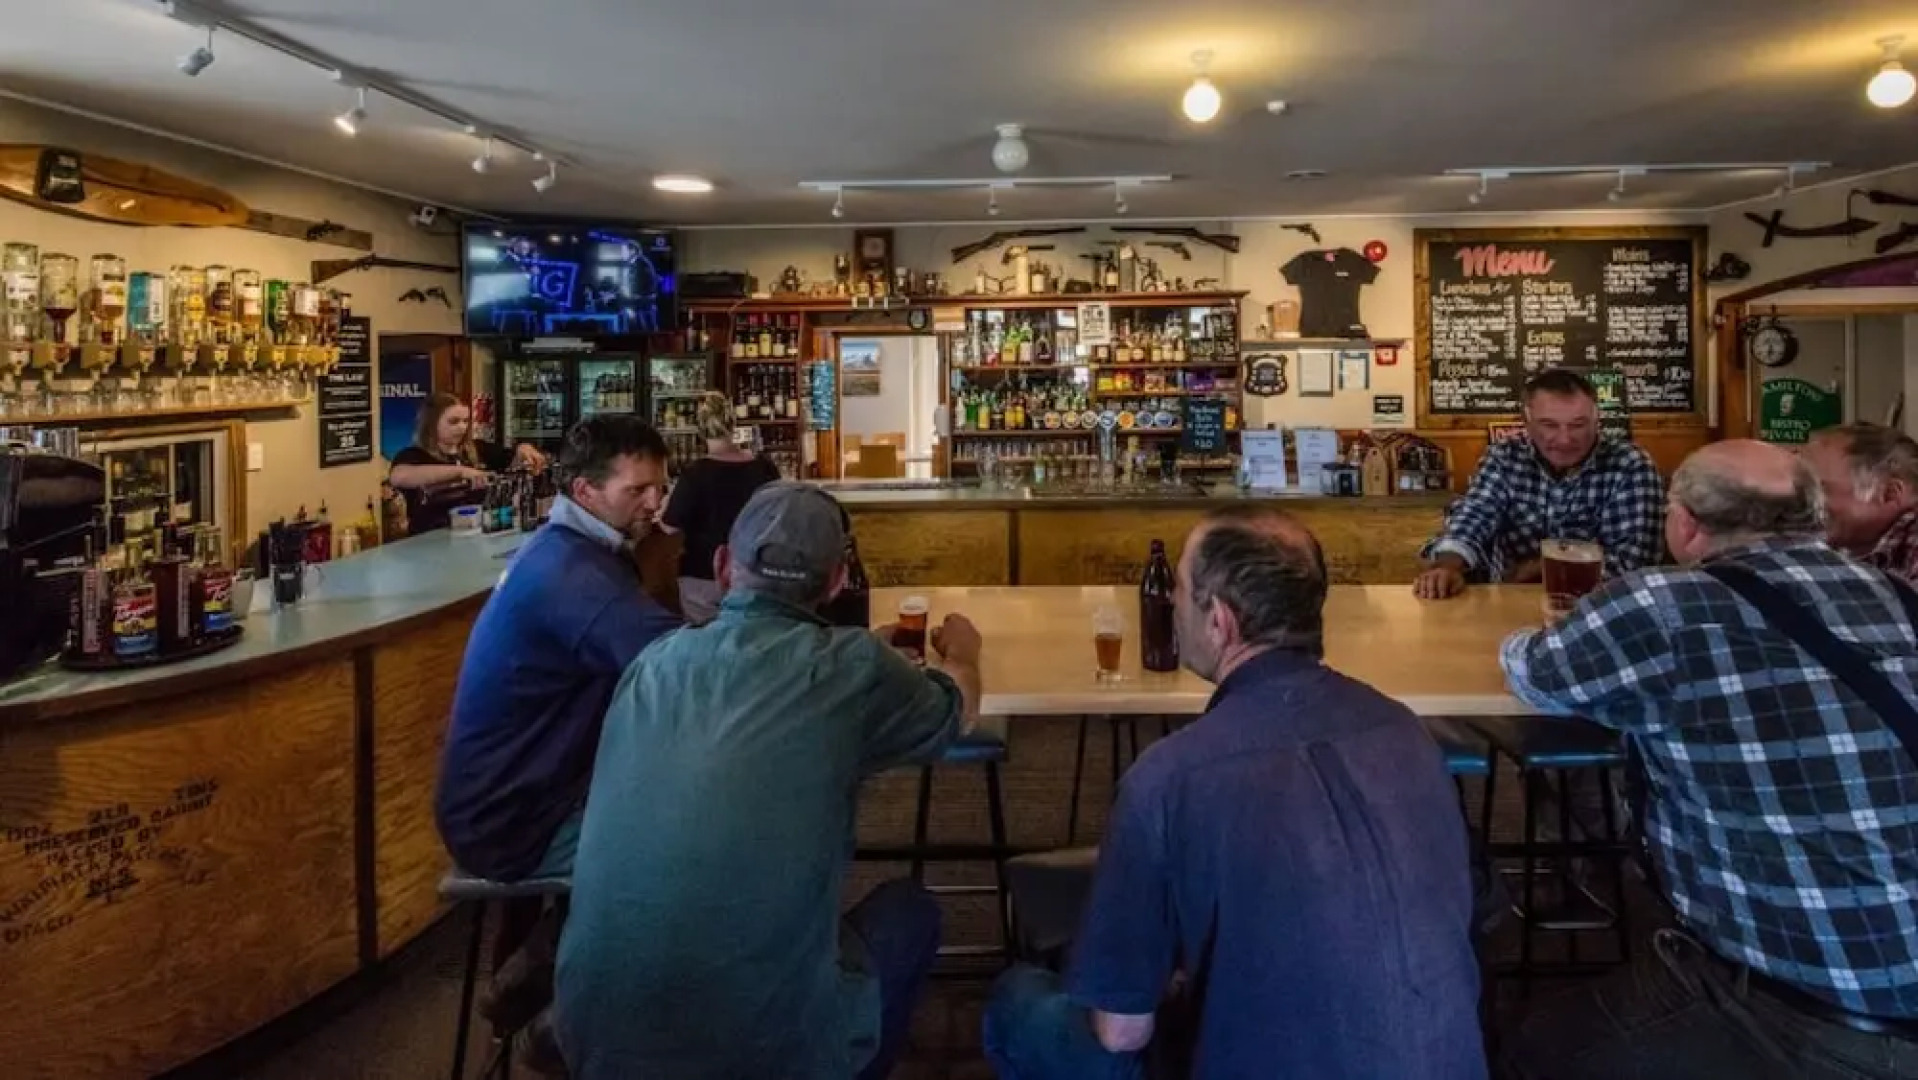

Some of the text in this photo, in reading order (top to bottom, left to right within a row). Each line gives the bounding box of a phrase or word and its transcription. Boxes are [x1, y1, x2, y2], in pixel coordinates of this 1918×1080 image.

[1453, 244, 1556, 277] Menu
[1439, 280, 1491, 296] Lunches
[1521, 279, 1573, 294] Starters
[1770, 418, 1811, 430] BISTRO
[4, 914, 75, 942] OTAGO
